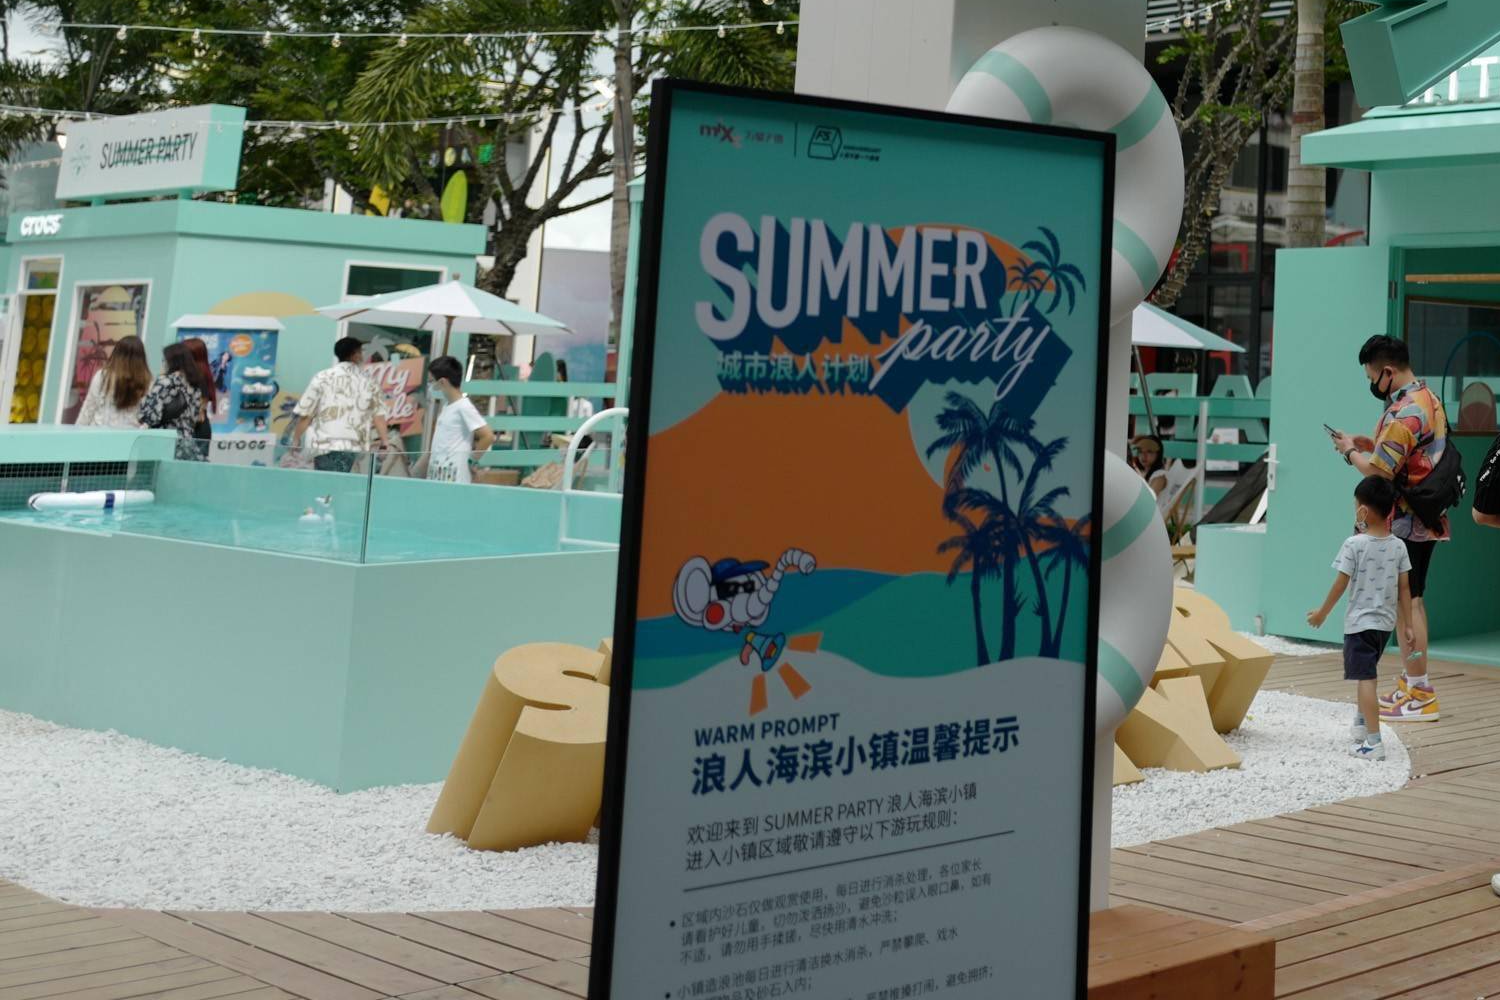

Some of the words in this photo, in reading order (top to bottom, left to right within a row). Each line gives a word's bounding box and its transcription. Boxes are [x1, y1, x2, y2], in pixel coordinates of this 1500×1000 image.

[99, 137, 154, 169] SUMMER
[157, 132, 198, 161] PARTY
[20, 215, 63, 236] crocs
[694, 211, 988, 340] SUMMER
[716, 351, 870, 383] 城市浪人计划
[869, 297, 1052, 400] party
[695, 722, 755, 747] WARM
[761, 713, 840, 738] PROMPT
[691, 716, 1020, 796] 浪人海滨小镇温馨提示
[687, 816, 759, 846] 欢迎来到
[763, 806, 834, 832] SUMMER
[838, 798, 885, 822] PARTY
[887, 782, 977, 814] 浪人海滨小镇
